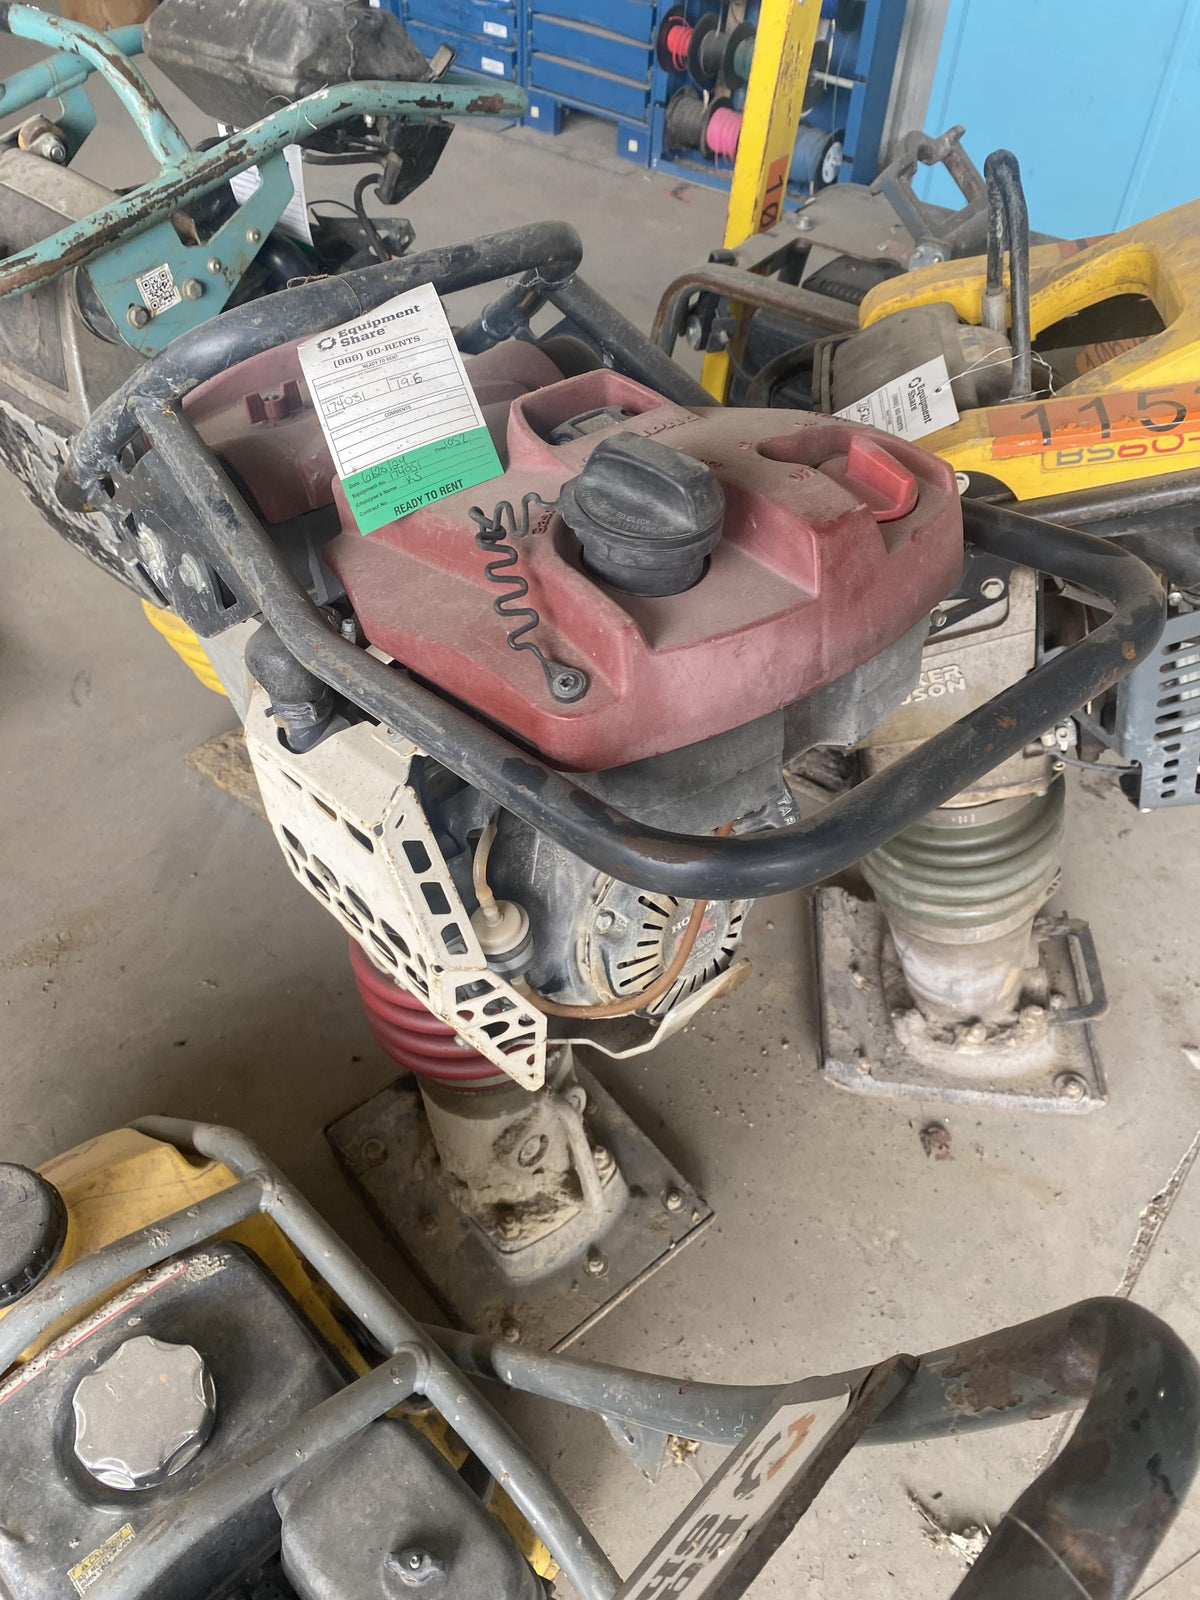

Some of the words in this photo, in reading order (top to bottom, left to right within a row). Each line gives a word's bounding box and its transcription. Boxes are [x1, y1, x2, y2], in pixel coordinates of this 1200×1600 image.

[337, 304, 421, 338] Equipment
[340, 328, 386, 347] Share
[333, 352, 364, 368] (888)
[366, 335, 420, 357] 80-RENTS
[326, 391, 366, 412] 174051
[384, 405, 412, 417] COMMENTS
[907, 389, 918, 412] Share
[917, 383, 933, 424] Equipment
[1020, 387, 1200, 446] 115
[348, 481, 360, 489] Date
[351, 484, 378, 499] Equipment
[355, 490, 384, 508] Employee's
[384, 486, 397, 494] Name
[393, 495, 423, 516] READY
[424, 490, 438, 502] TO
[439, 479, 464, 496] RENT
[360, 504, 380, 517] Contract
[626, 515, 651, 525] CLICK
